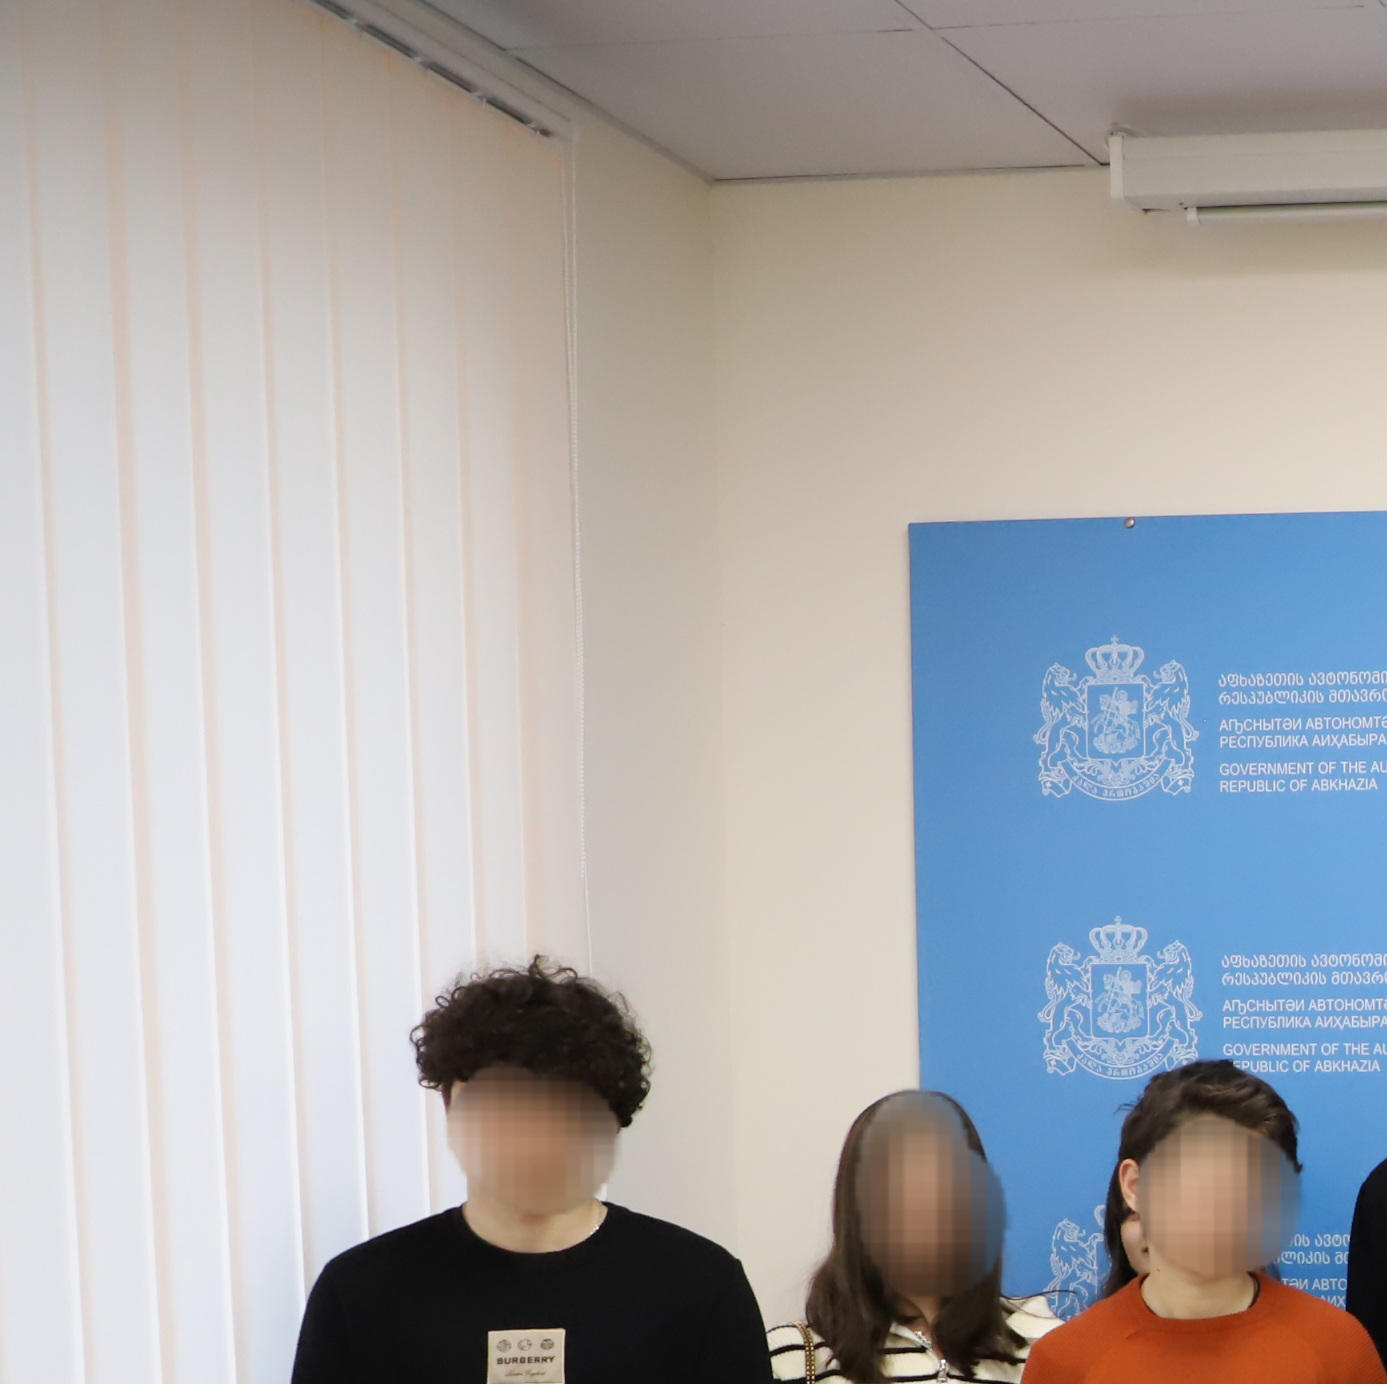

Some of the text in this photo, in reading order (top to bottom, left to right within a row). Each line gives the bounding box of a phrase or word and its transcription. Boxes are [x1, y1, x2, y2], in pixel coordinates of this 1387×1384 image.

[1219, 735, 1310, 749] РЕСПУБЛИКА
[1219, 762, 1315, 776] GOVERNMENT
[1317, 761, 1337, 774] OF
[1339, 761, 1368, 774] THE
[1219, 778, 1379, 792] REPUBLIC OF ABKHAZIA
[1222, 1015, 1312, 1029] РЕСПУБЛИКА
[1222, 1043, 1319, 1056] GOVERNMENT
[1320, 1043, 1340, 1056] OF
[1342, 1042, 1371, 1055] THE
[1232, 1059, 1381, 1073] EPUBLIC OF ABKHAZIA
[496, 1355, 556, 1365] BURBERRY
